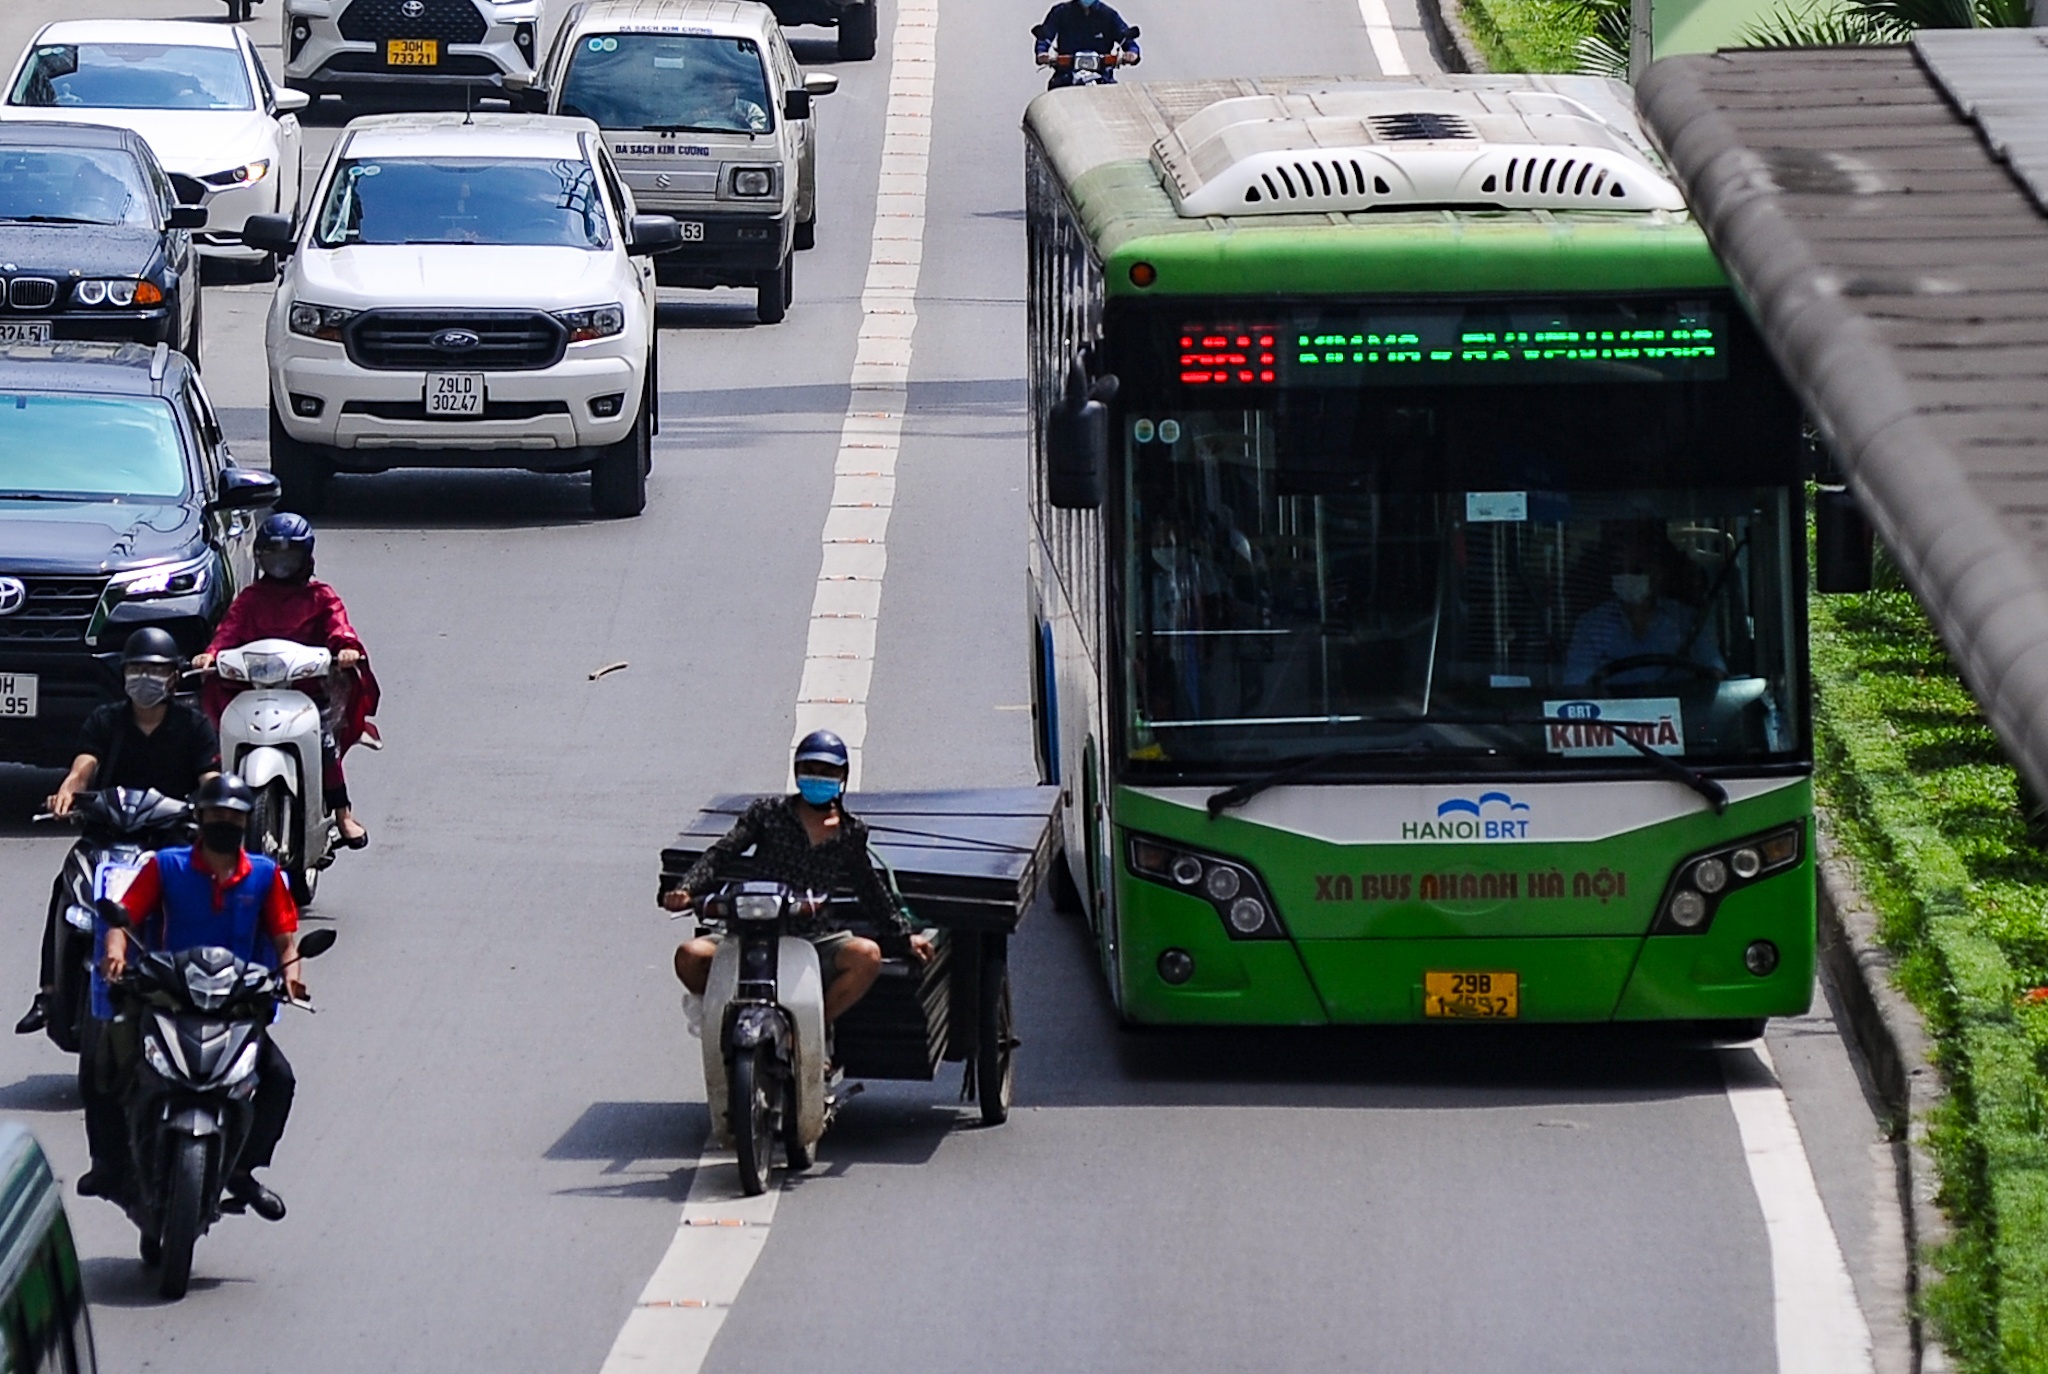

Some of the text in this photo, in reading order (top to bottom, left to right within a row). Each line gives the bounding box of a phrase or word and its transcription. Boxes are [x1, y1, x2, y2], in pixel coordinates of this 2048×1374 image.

[401, 41, 424, 52] 30H
[438, 377, 473, 394] 29LD
[1566, 704, 1594, 719] BRT
[1550, 723, 1615, 749] KIM
[1361, 873, 1413, 901] BUS
[1527, 866, 1566, 899] HÀ
[1451, 974, 1492, 995] 29B
